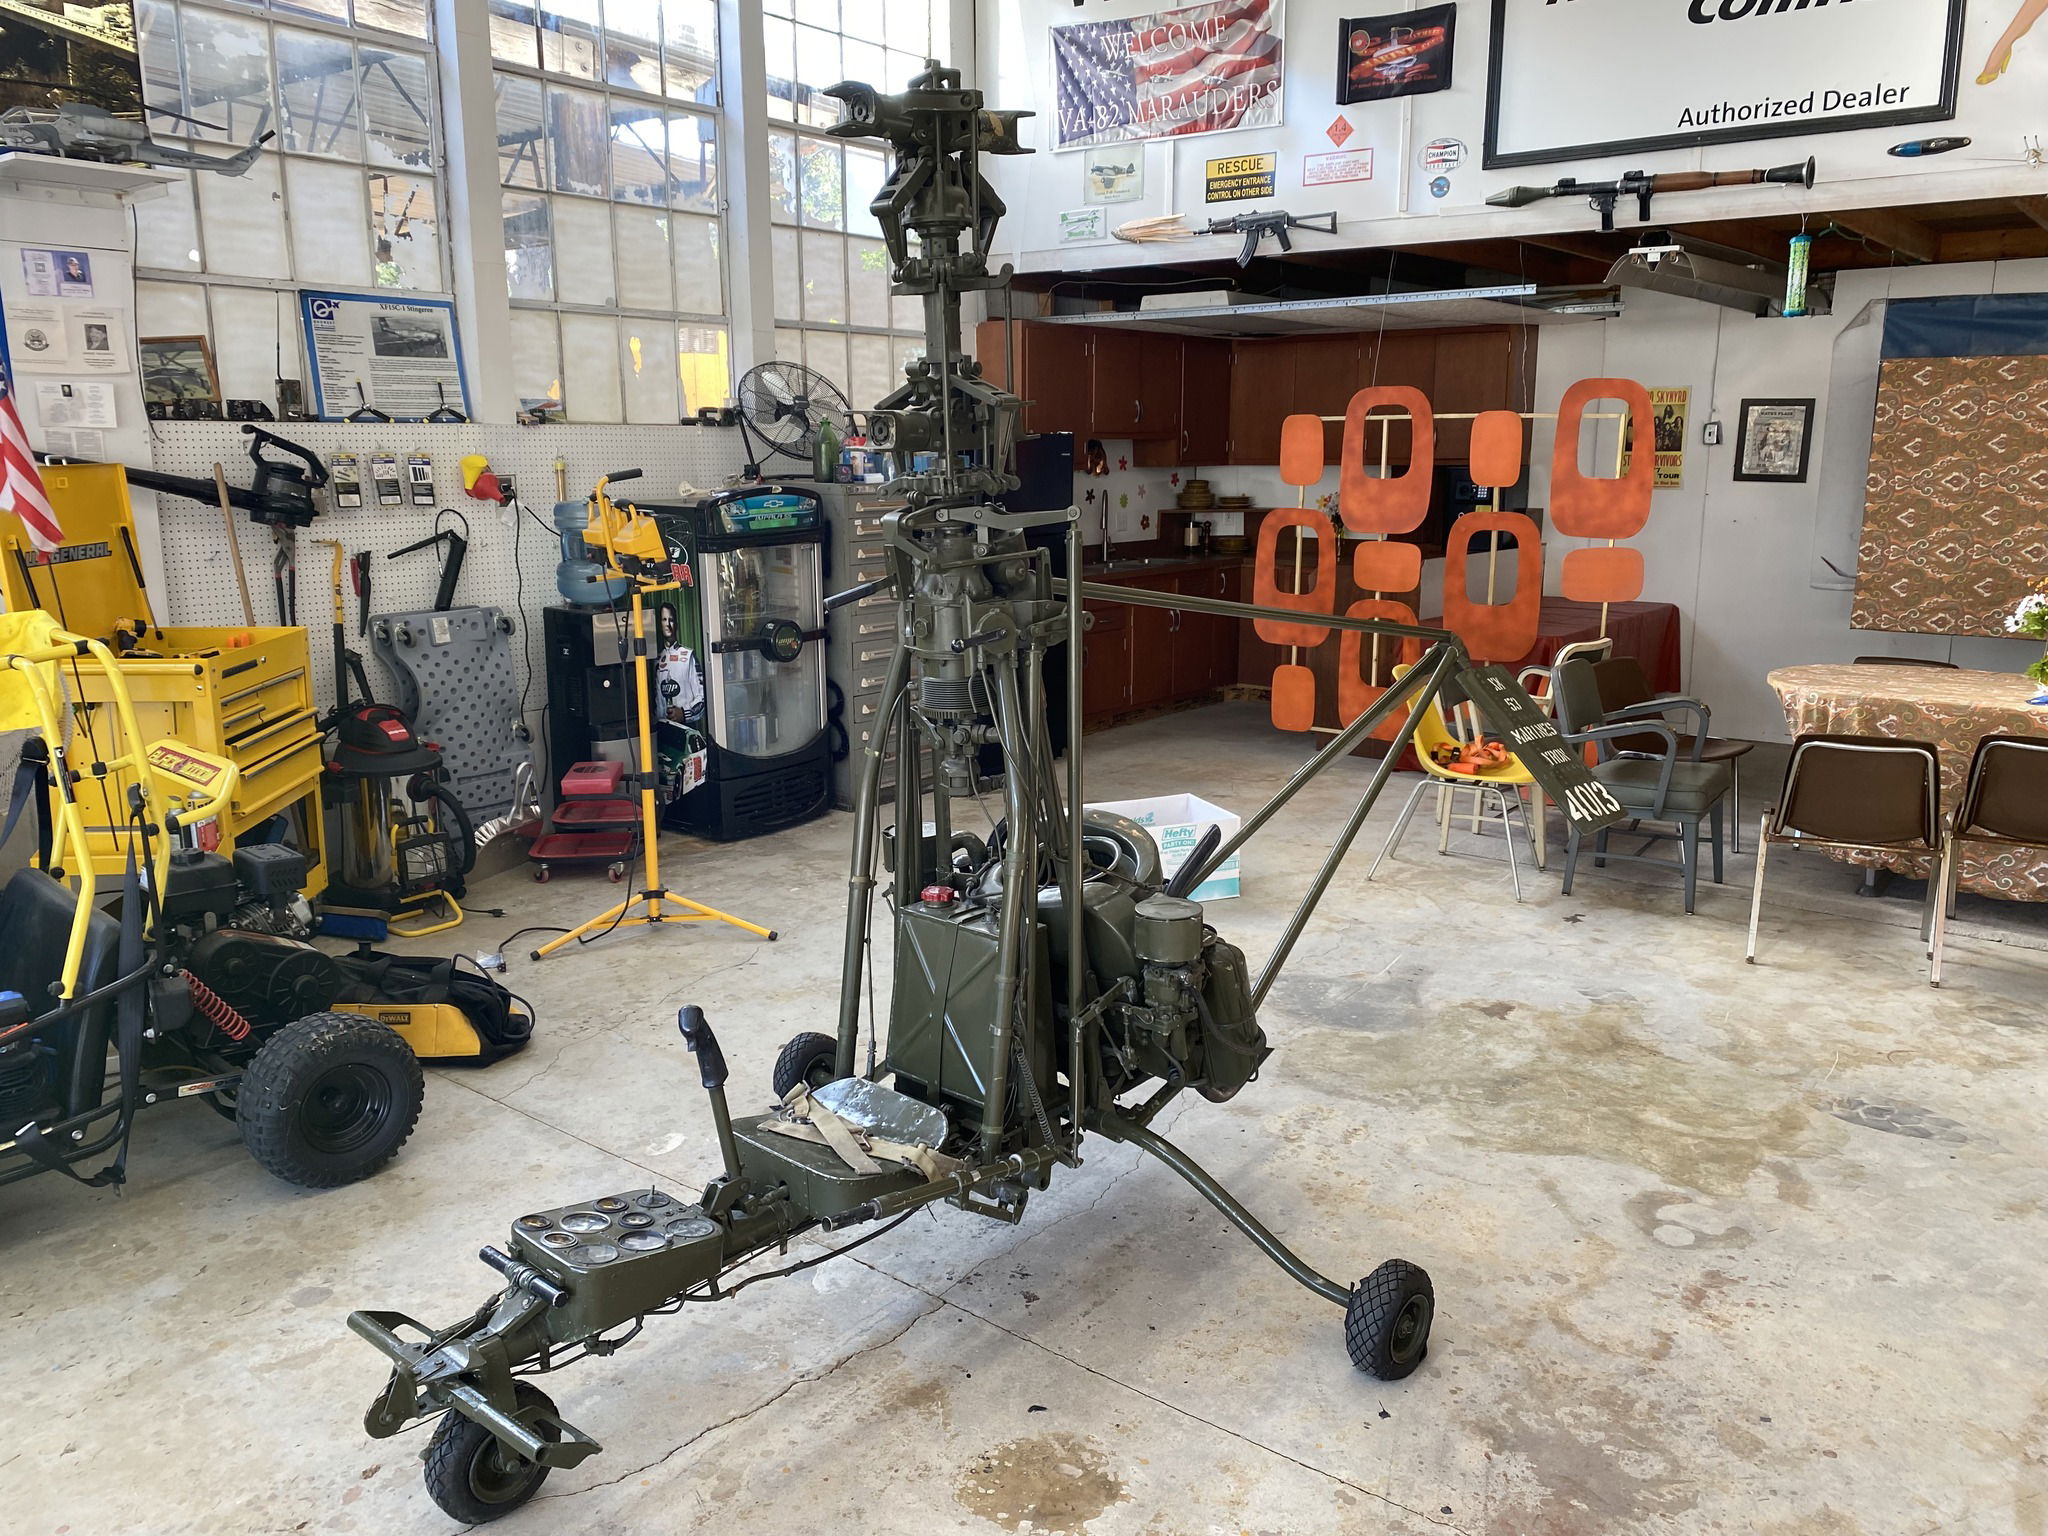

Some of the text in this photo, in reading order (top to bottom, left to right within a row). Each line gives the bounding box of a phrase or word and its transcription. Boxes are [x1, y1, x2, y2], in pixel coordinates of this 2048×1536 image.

[1100, 15, 1229, 61] WELCOME
[1058, 80, 1278, 135] VA-82 MARAUDERS
[1677, 83, 1910, 128] Authorized Dealer
[1428, 150, 1457, 159] CHAMPION
[1217, 157, 1264, 175] RESCUE
[1209, 175, 1272, 190] EMERGENCY ENTRANCE
[1207, 185, 1273, 201] CONTROL ON OTHER SIDE
[51, 542, 112, 563] GENERAL
[1504, 697, 1522, 712] 53
[1510, 722, 1557, 745] MARINES
[1564, 780, 1621, 822] 4013
[1164, 827, 1194, 839] Hefty
